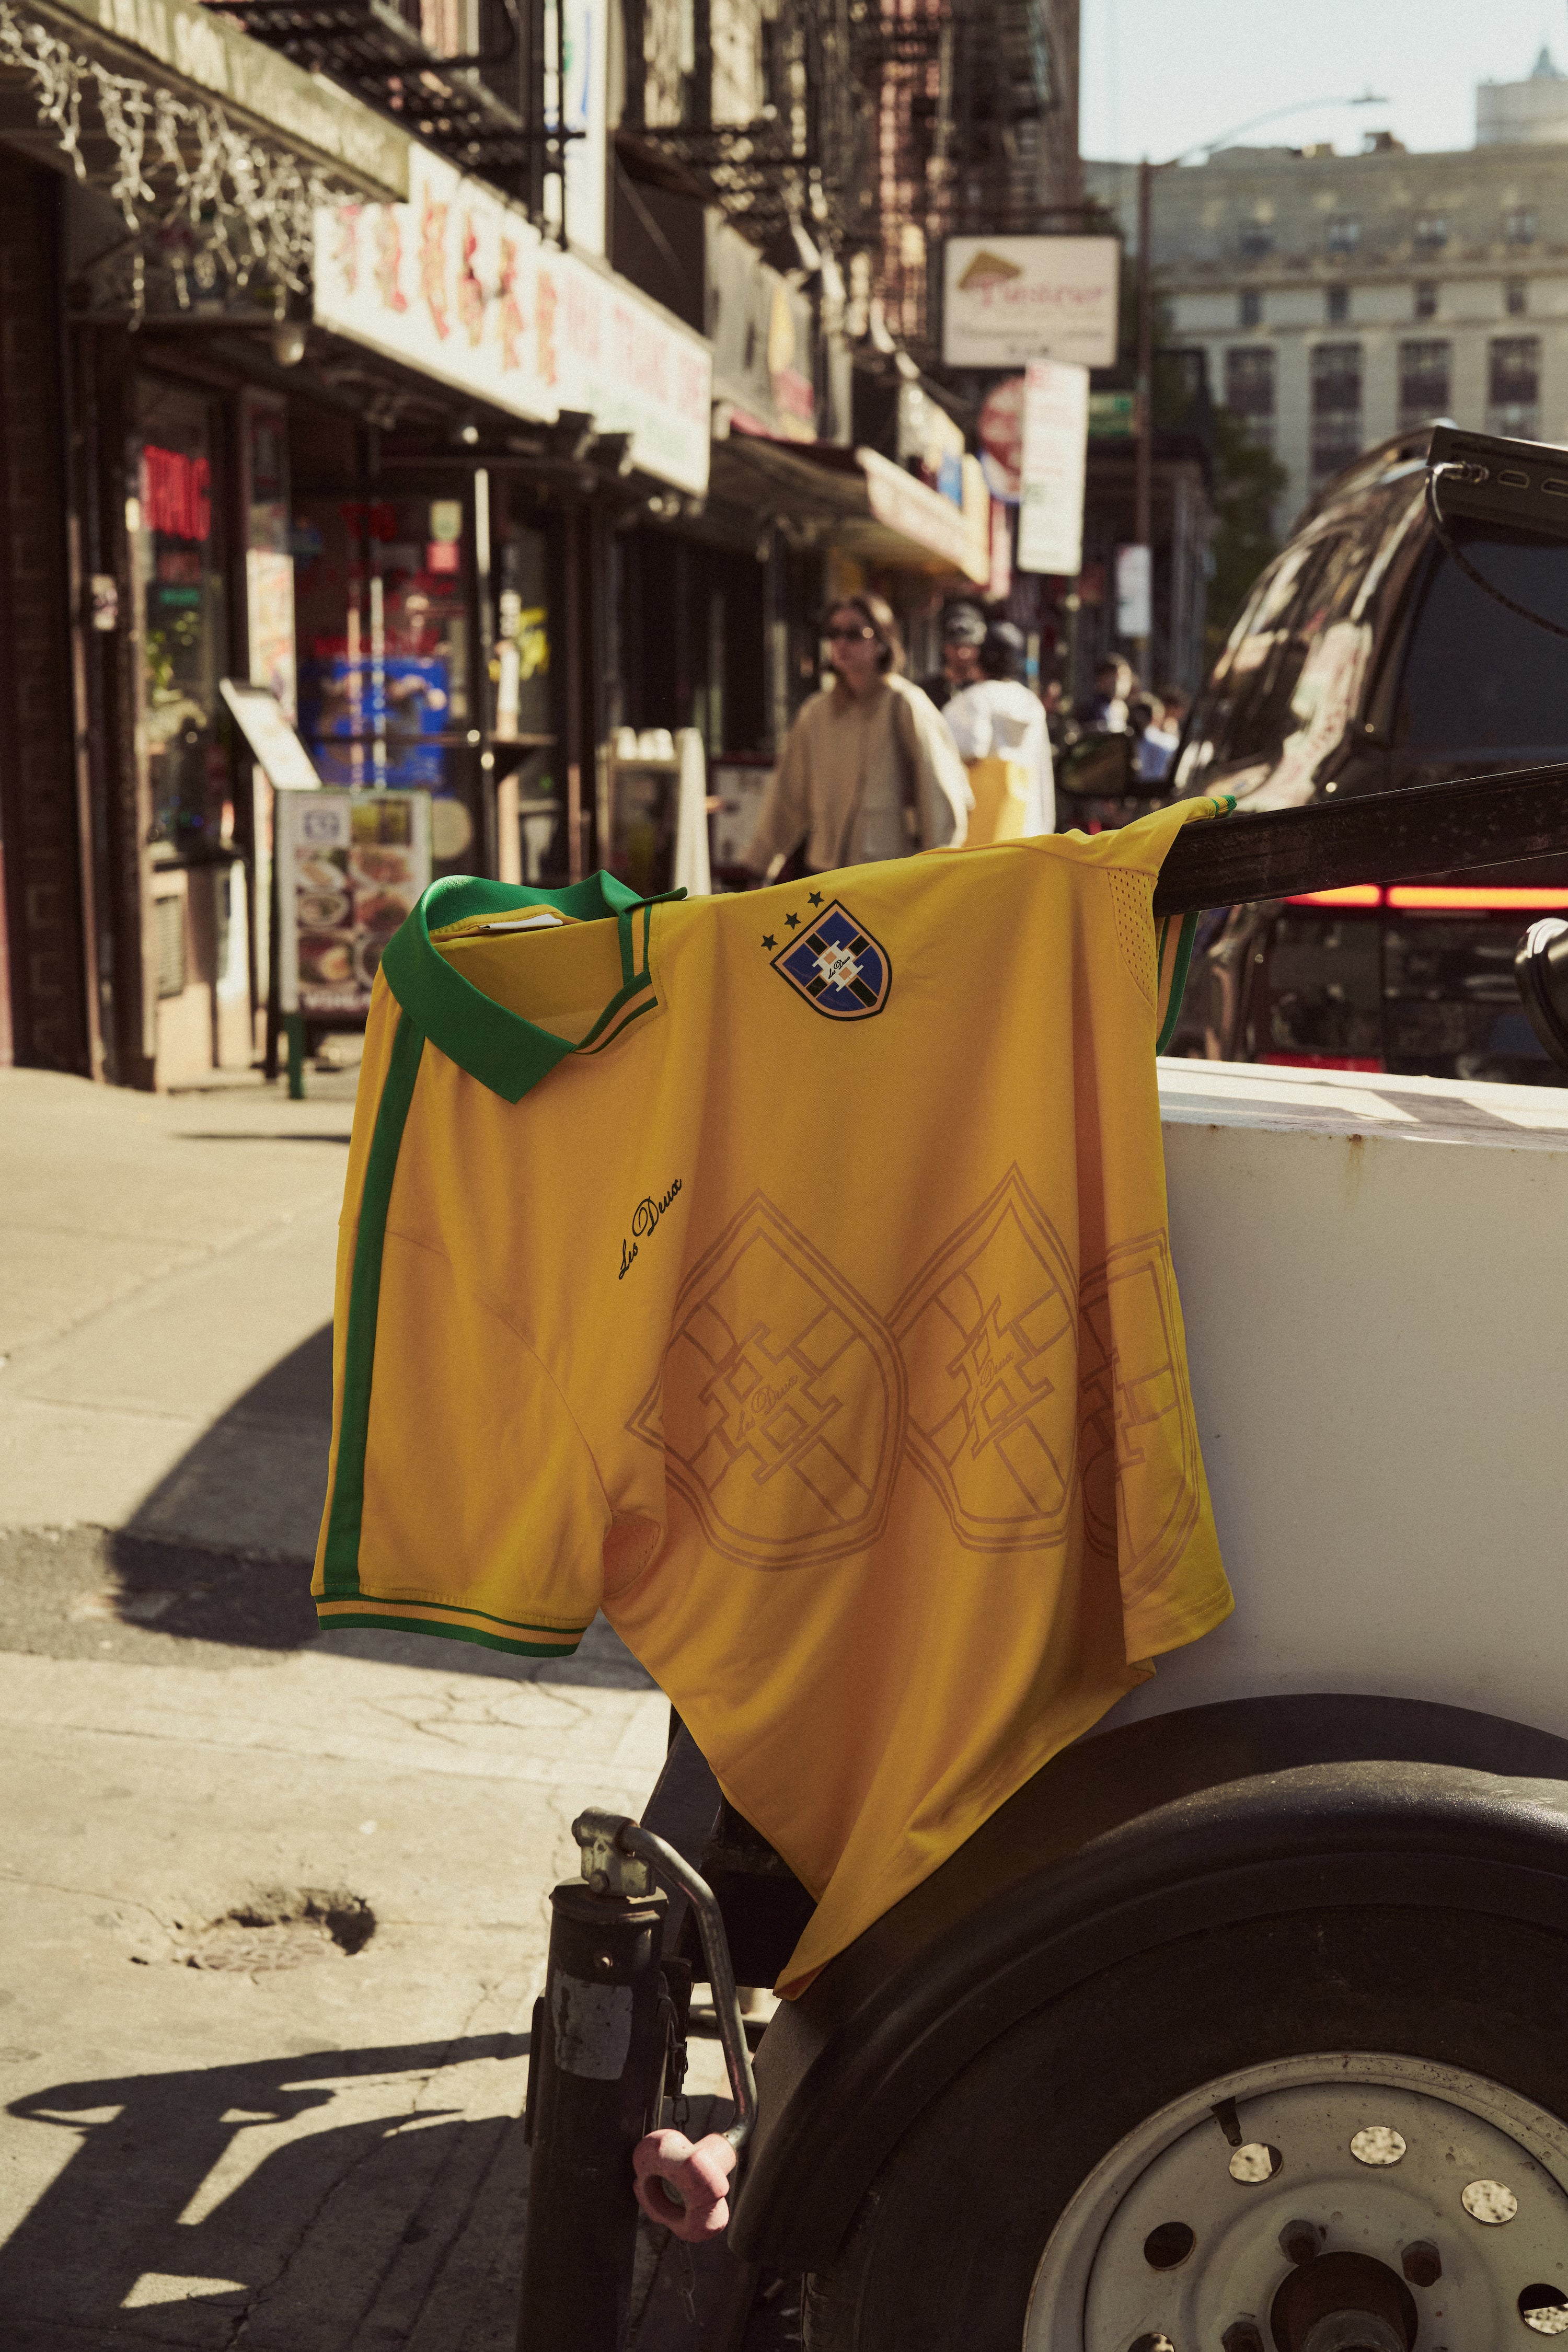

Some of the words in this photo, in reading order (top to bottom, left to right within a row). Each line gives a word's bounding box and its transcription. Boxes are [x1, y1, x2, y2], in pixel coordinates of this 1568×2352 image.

[834, 956, 850, 970] Deux
[619, 1238, 638, 1279] Les
[632, 1179, 682, 1237] Deux
[735, 1410, 756, 1442] Les
[751, 1375, 798, 1415] Deux
